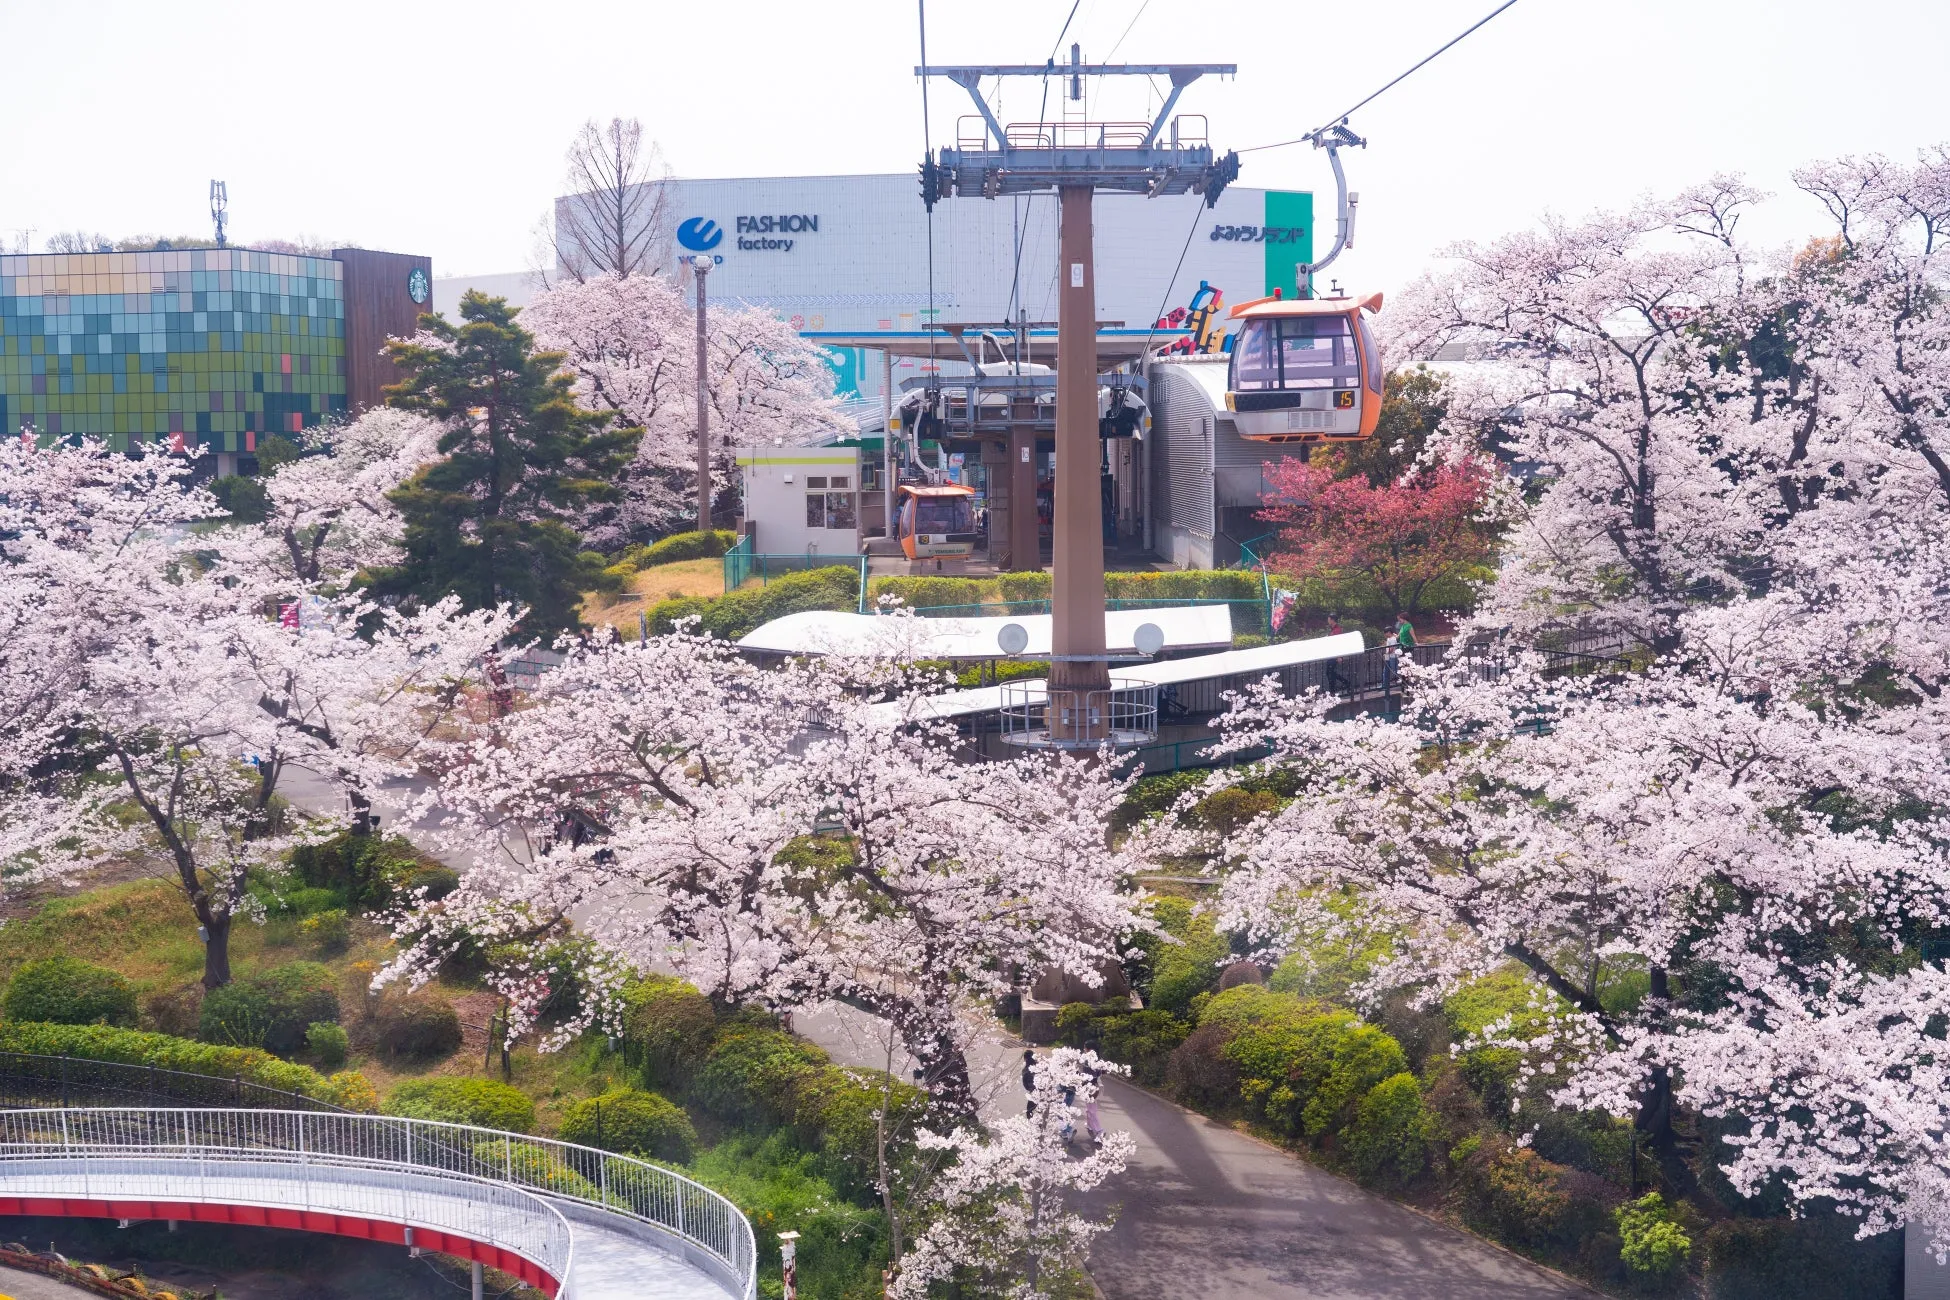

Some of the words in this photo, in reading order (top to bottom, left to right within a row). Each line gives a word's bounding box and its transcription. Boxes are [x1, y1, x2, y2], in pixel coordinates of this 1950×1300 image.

[736, 214, 818, 233] FASHION
[1210, 225, 1304, 243] よみうりランド
[737, 236, 793, 252] factory
[1340, 392, 1352, 406] 15
